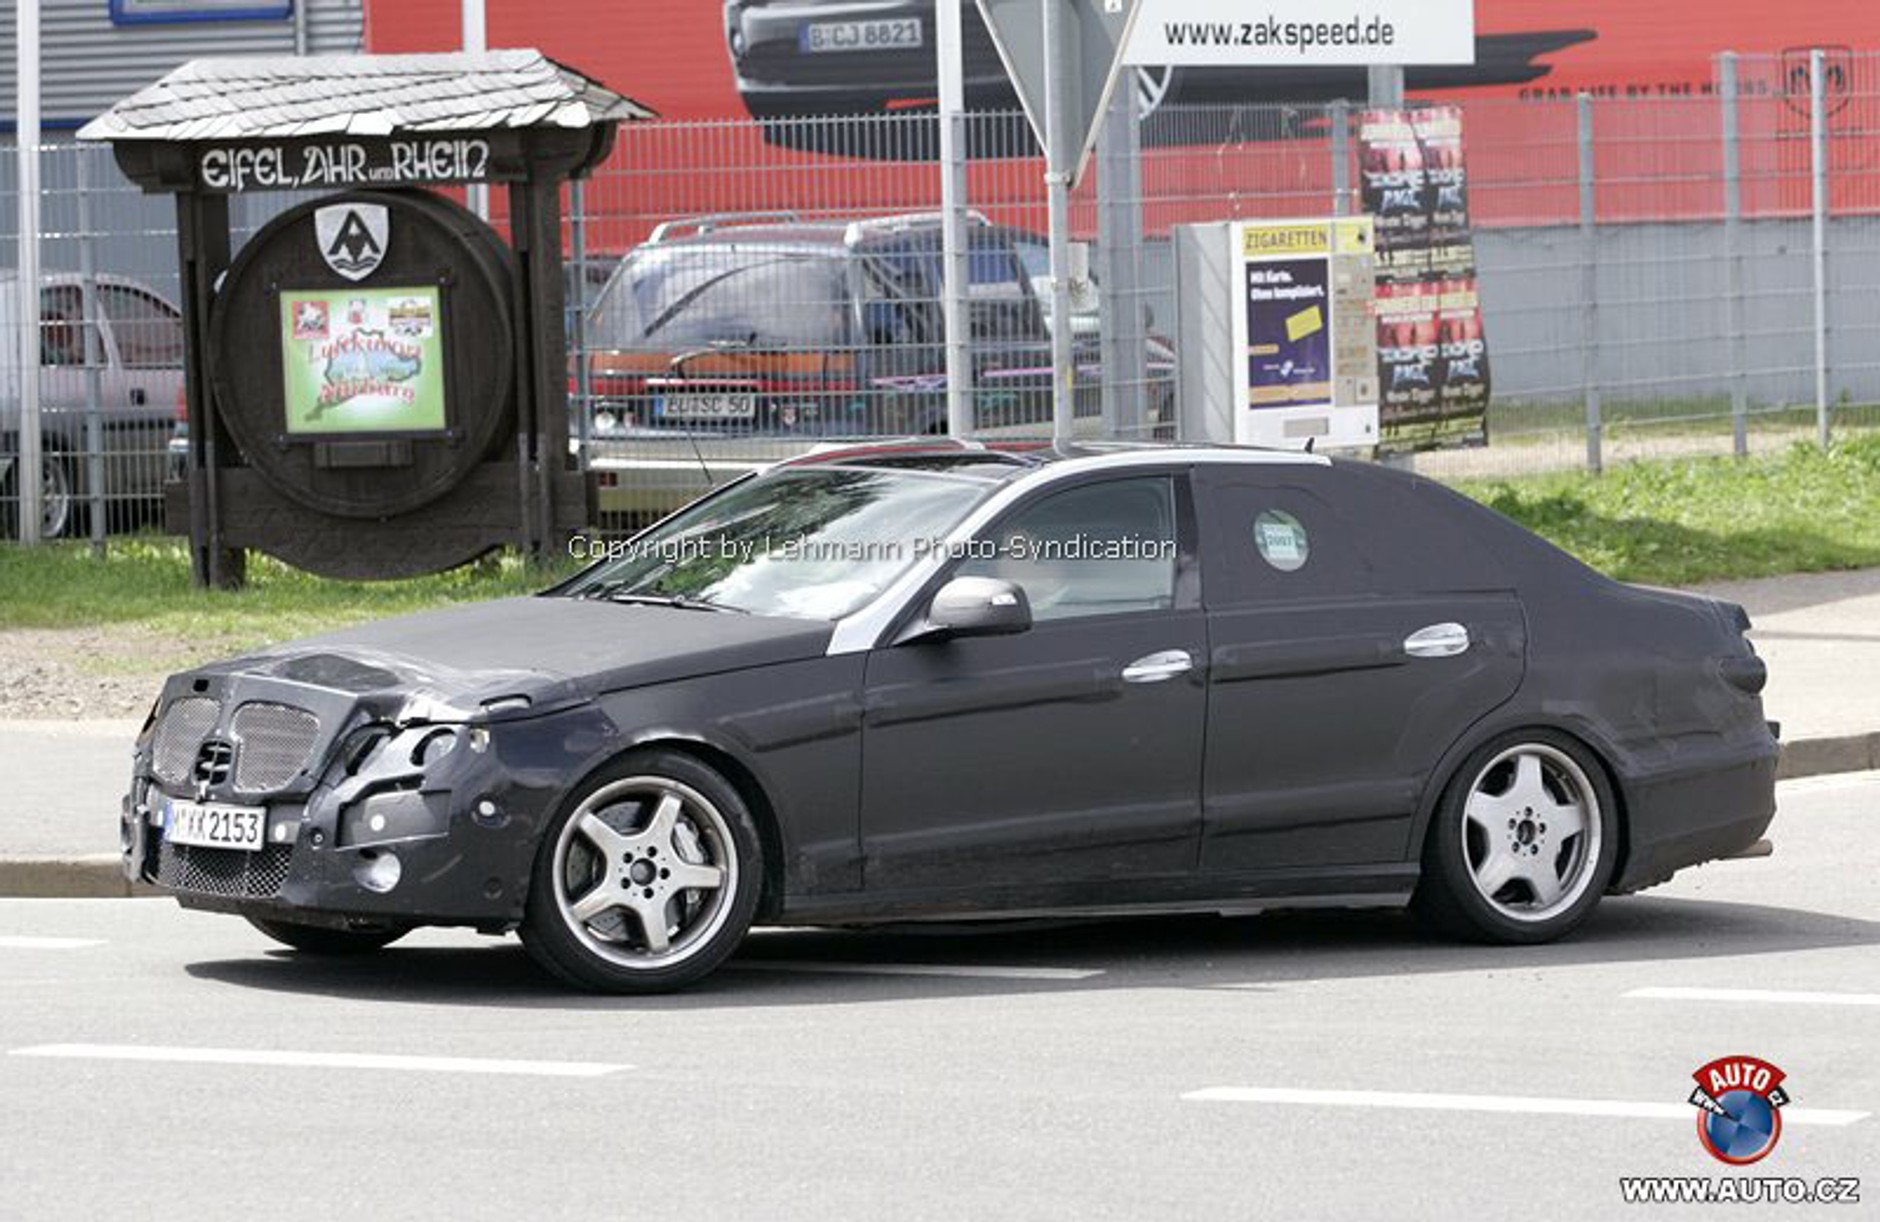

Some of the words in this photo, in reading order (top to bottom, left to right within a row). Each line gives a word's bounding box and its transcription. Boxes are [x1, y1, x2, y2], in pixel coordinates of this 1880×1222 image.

[1164, 15, 1395, 54] www.zakspeed.de
[1657, 82, 1692, 95] THE
[1246, 230, 1328, 249] ZIGARETTEN
[208, 811, 260, 844] 2153
